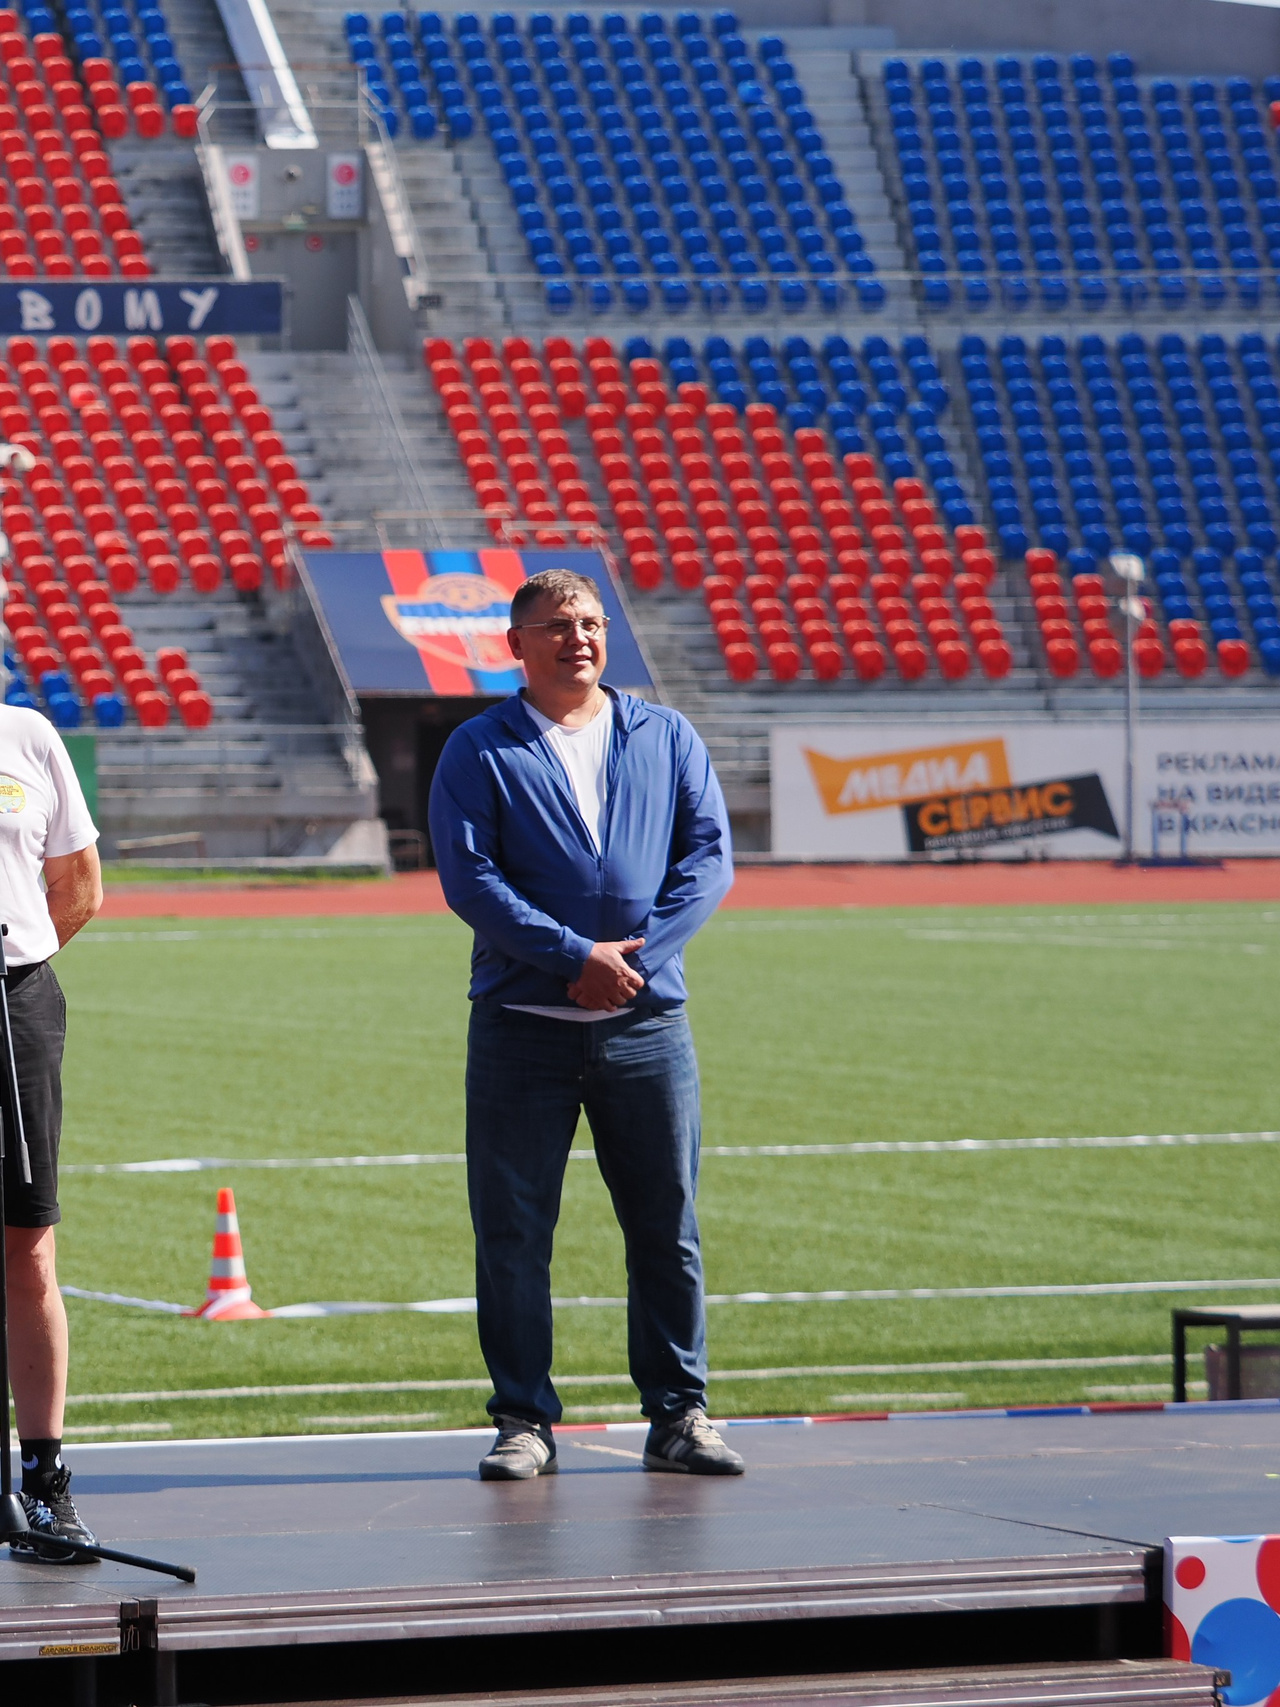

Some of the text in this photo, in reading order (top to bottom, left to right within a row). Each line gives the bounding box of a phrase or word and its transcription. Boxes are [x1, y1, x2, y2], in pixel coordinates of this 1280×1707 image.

[1156, 752, 1280, 773] РЕКЛАМ
[1156, 783, 1196, 802] НА
[917, 781, 1074, 836] СЕРВИС
